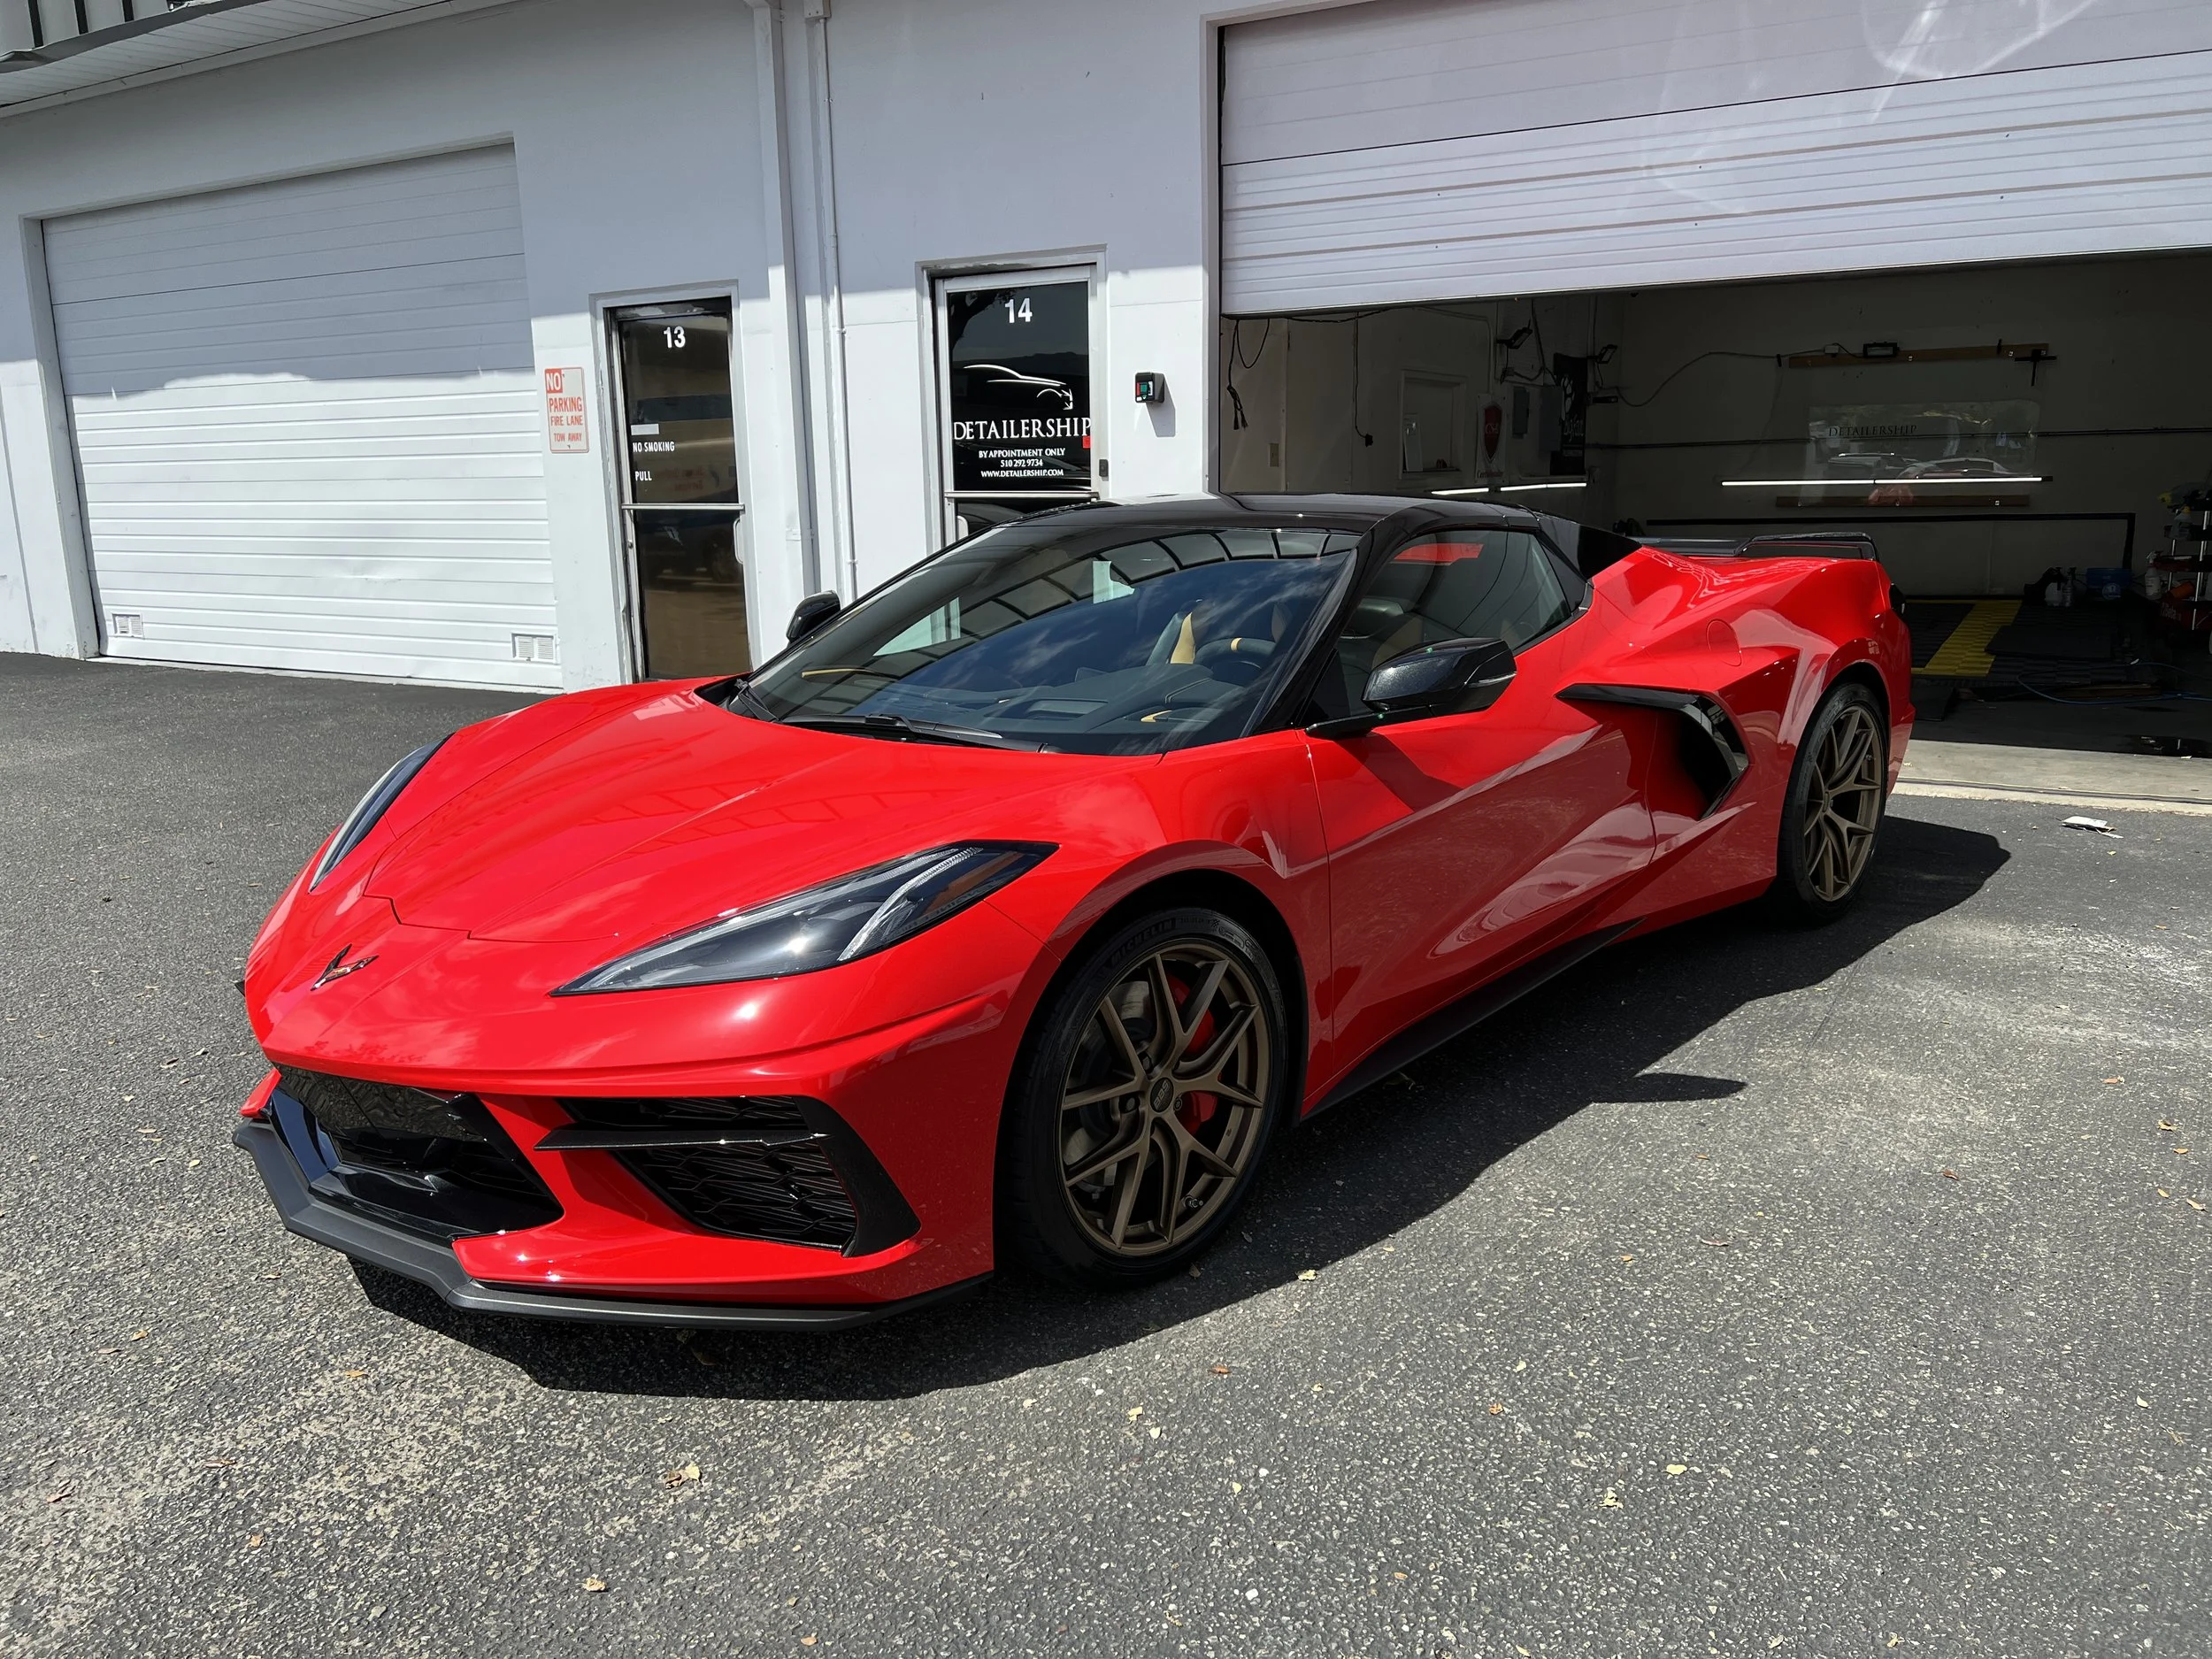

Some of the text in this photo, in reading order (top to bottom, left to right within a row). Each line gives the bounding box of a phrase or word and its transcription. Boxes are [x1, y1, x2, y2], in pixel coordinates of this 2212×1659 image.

[1004, 297, 1033, 323] 14
[664, 326, 686, 349] 13
[546, 373, 562, 391] NO
[549, 397, 582, 413] PARKING
[550, 415, 583, 426] FIRE LANE
[953, 418, 1091, 440] DETAILERSHIP
[554, 432, 582, 442] TOW AWAY
[633, 442, 675, 453] NO SMOKING
[979, 448, 1066, 458] BY APPOINTMENT ONLY
[1026, 458, 1043, 467] 9734
[635, 471, 652, 481] PULL
[980, 469, 1064, 478] WWW.DETAILERSHIP.COM
[1153, 1079, 1169, 1110] BBS
